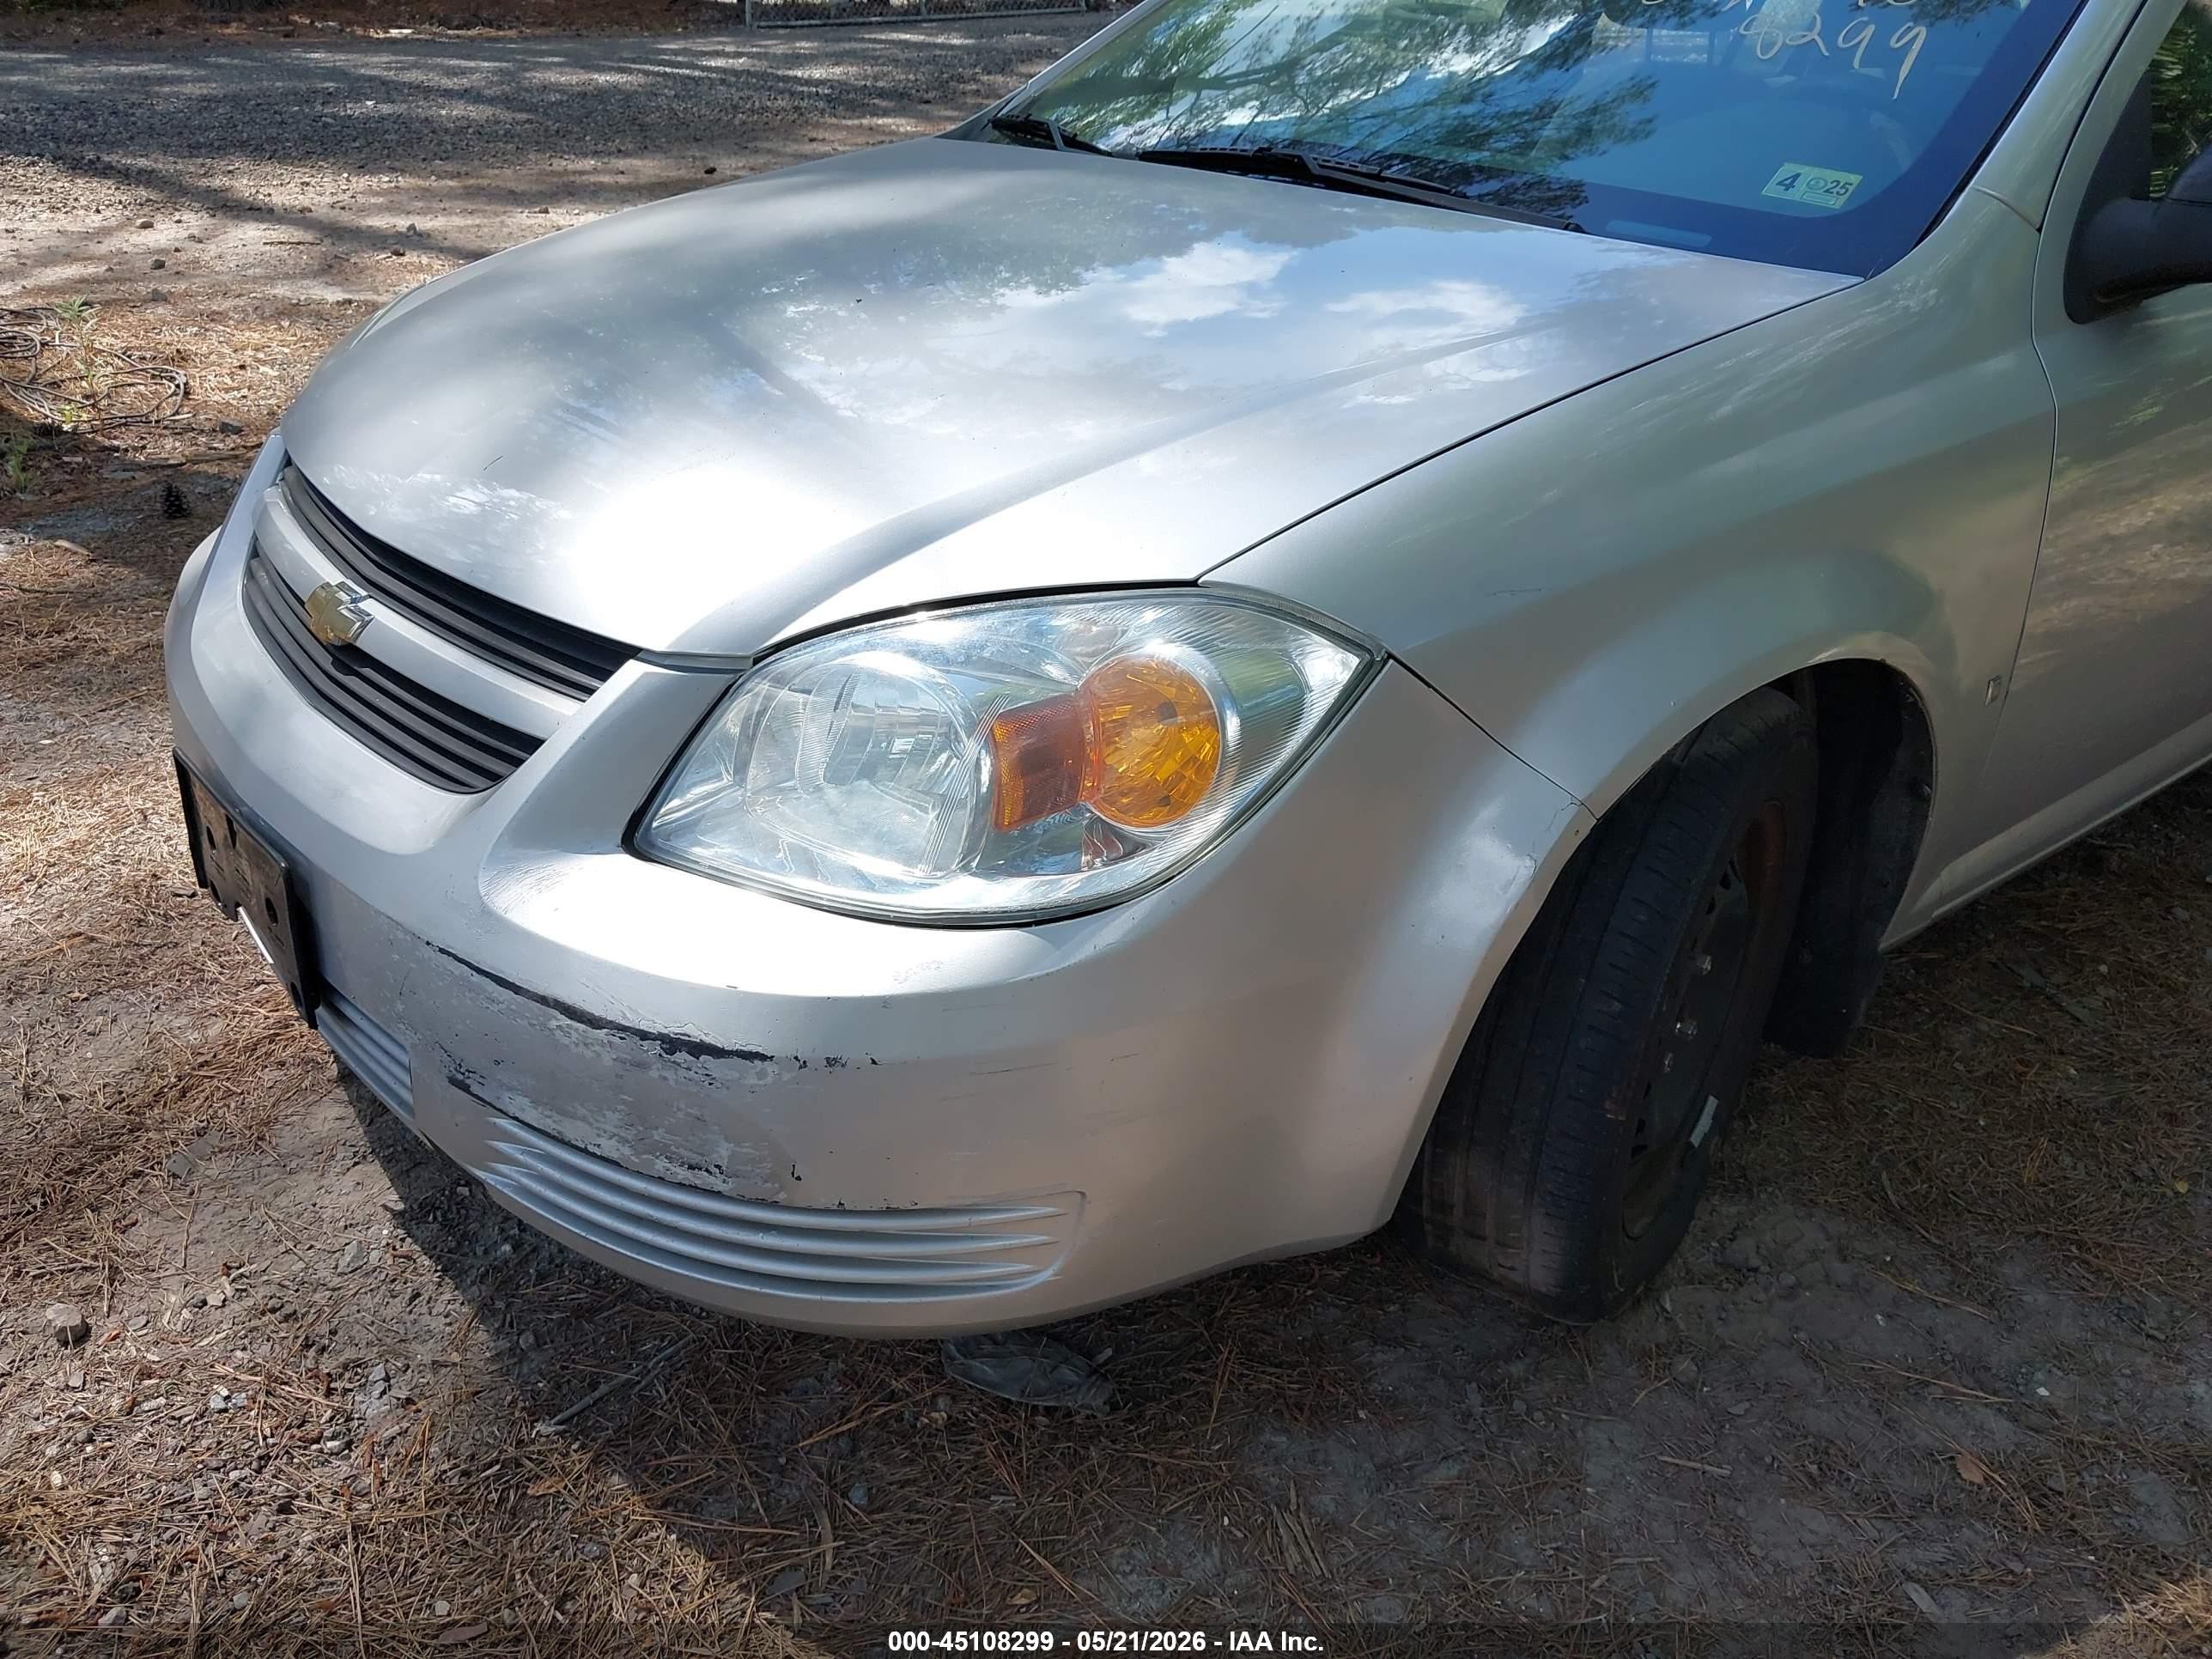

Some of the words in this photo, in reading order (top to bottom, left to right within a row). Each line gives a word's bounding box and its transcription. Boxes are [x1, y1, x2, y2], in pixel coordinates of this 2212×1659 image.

[1739, 12, 1928, 100] 8299
[1775, 172, 1802, 191] 4
[1822, 179, 1854, 197] 25
